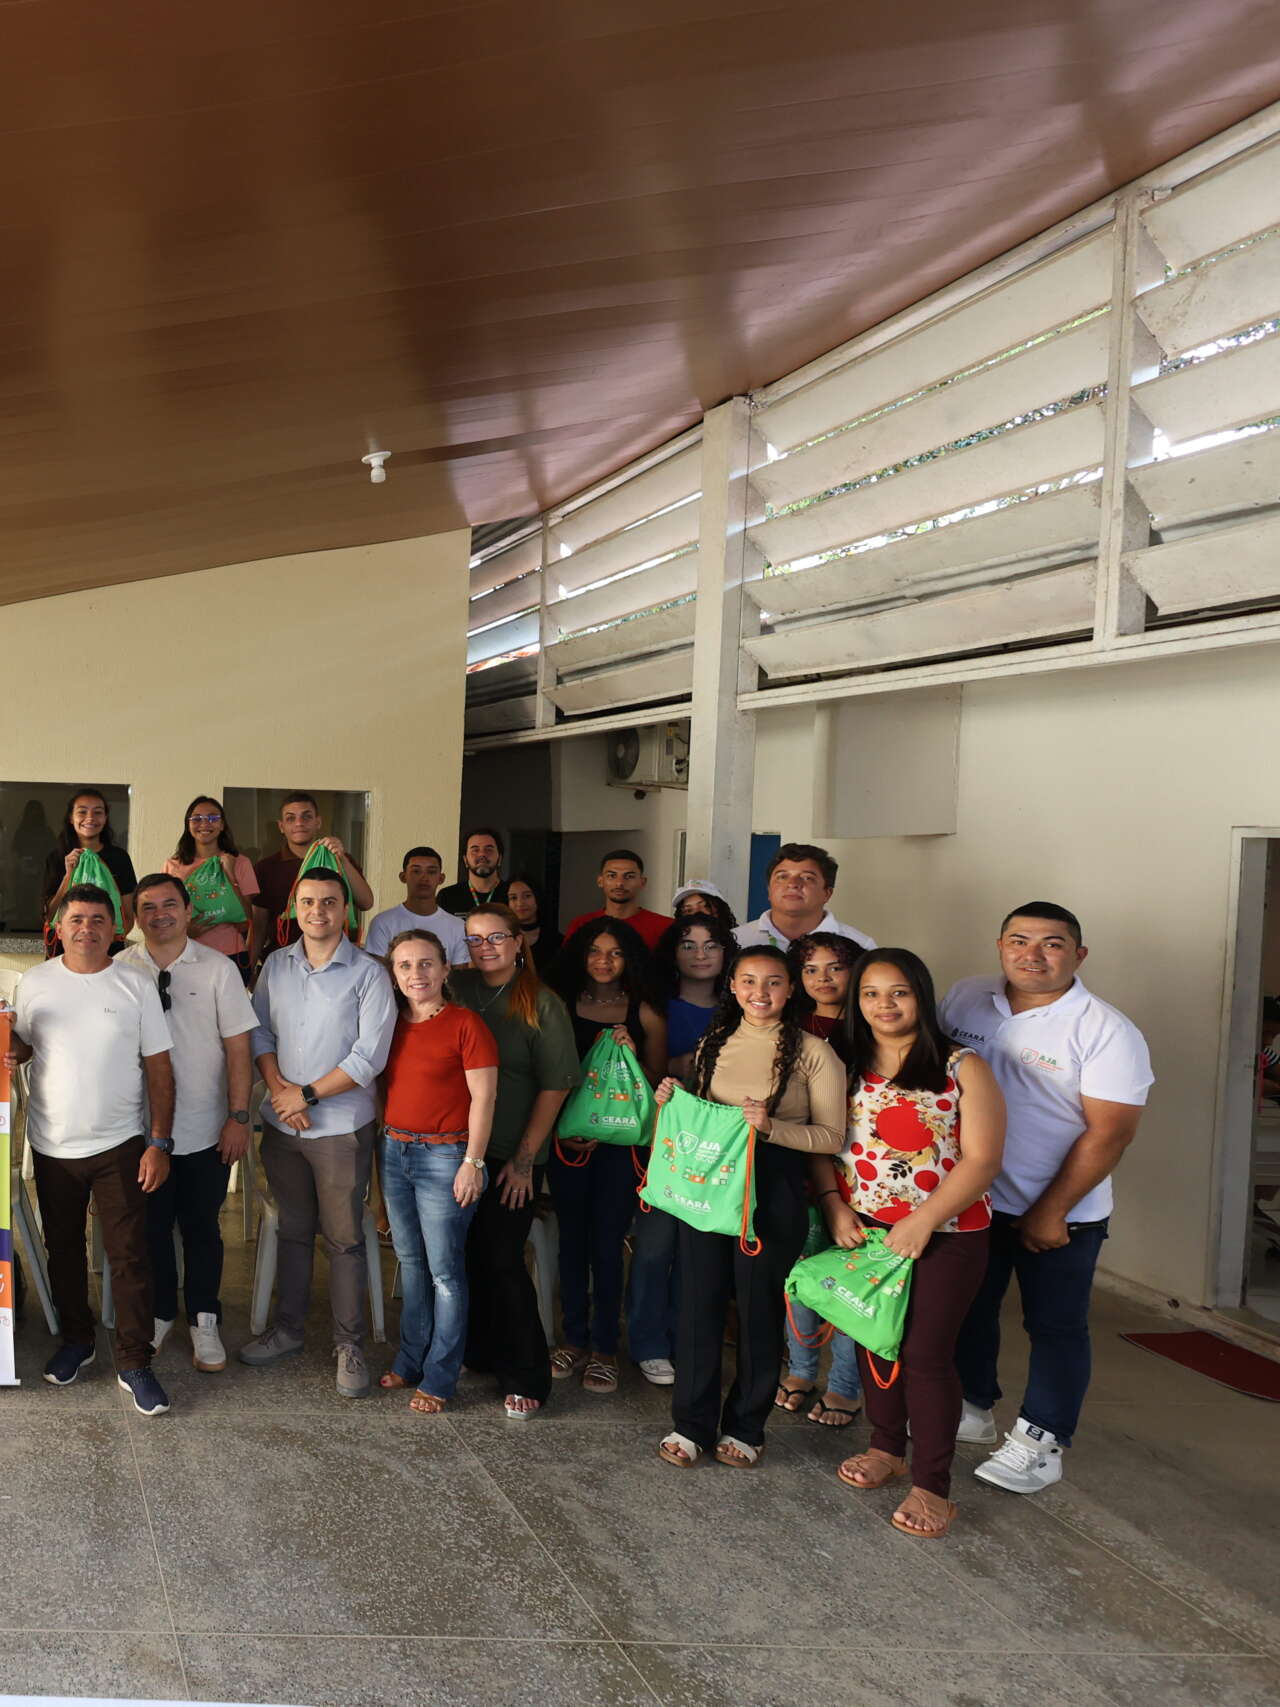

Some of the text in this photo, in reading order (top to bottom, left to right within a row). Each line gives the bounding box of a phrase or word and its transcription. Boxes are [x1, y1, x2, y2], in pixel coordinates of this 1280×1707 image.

[1039, 1055, 1057, 1066] AJA
[602, 1115, 637, 1127] CEARÁ
[699, 1141, 721, 1151] AJA
[674, 1193, 711, 1210] CEARÁ
